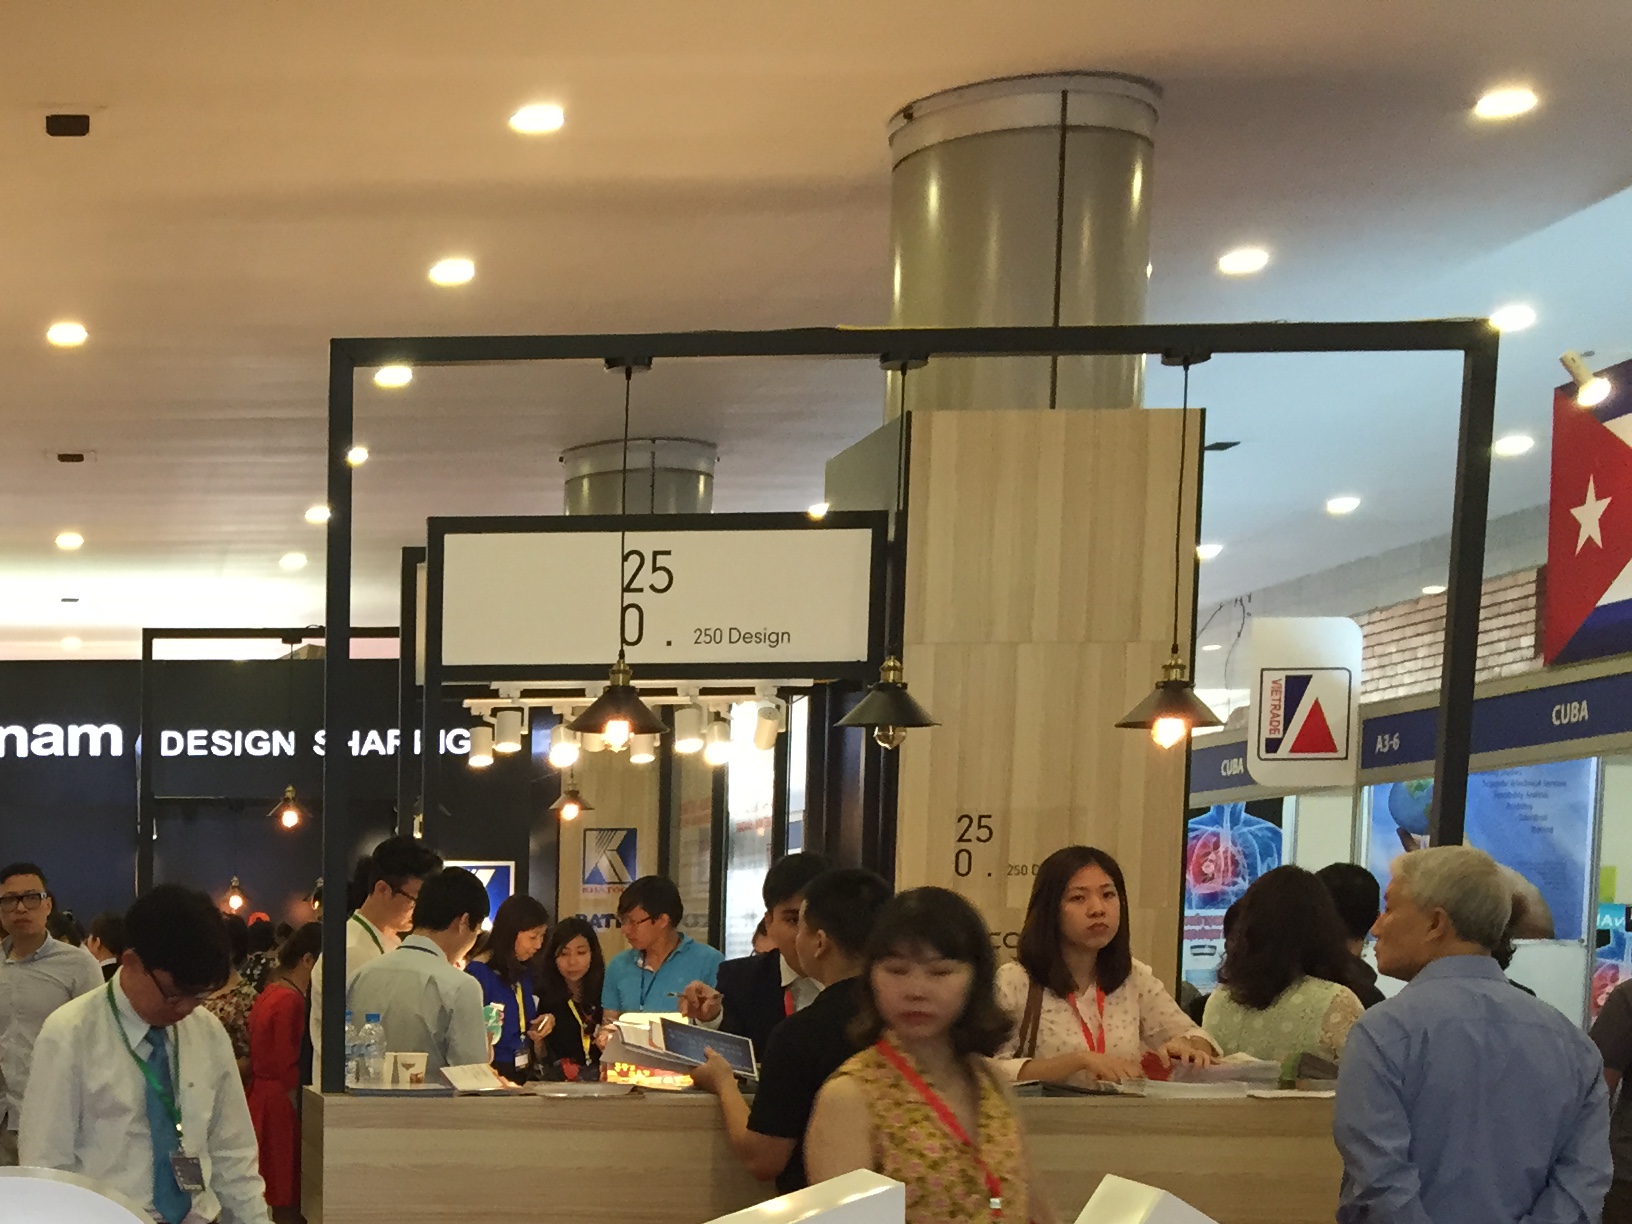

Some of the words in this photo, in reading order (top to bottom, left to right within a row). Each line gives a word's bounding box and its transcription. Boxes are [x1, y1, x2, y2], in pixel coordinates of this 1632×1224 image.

[622, 549, 675, 594] 25
[693, 627, 723, 645] 250
[728, 627, 791, 648] Design
[1551, 700, 1590, 728] CUBA
[159, 728, 296, 757] DESIGN
[1374, 733, 1400, 754] A3-6
[1220, 756, 1244, 777] CUBA
[956, 813, 994, 844] 25
[1006, 864, 1028, 876] 250
